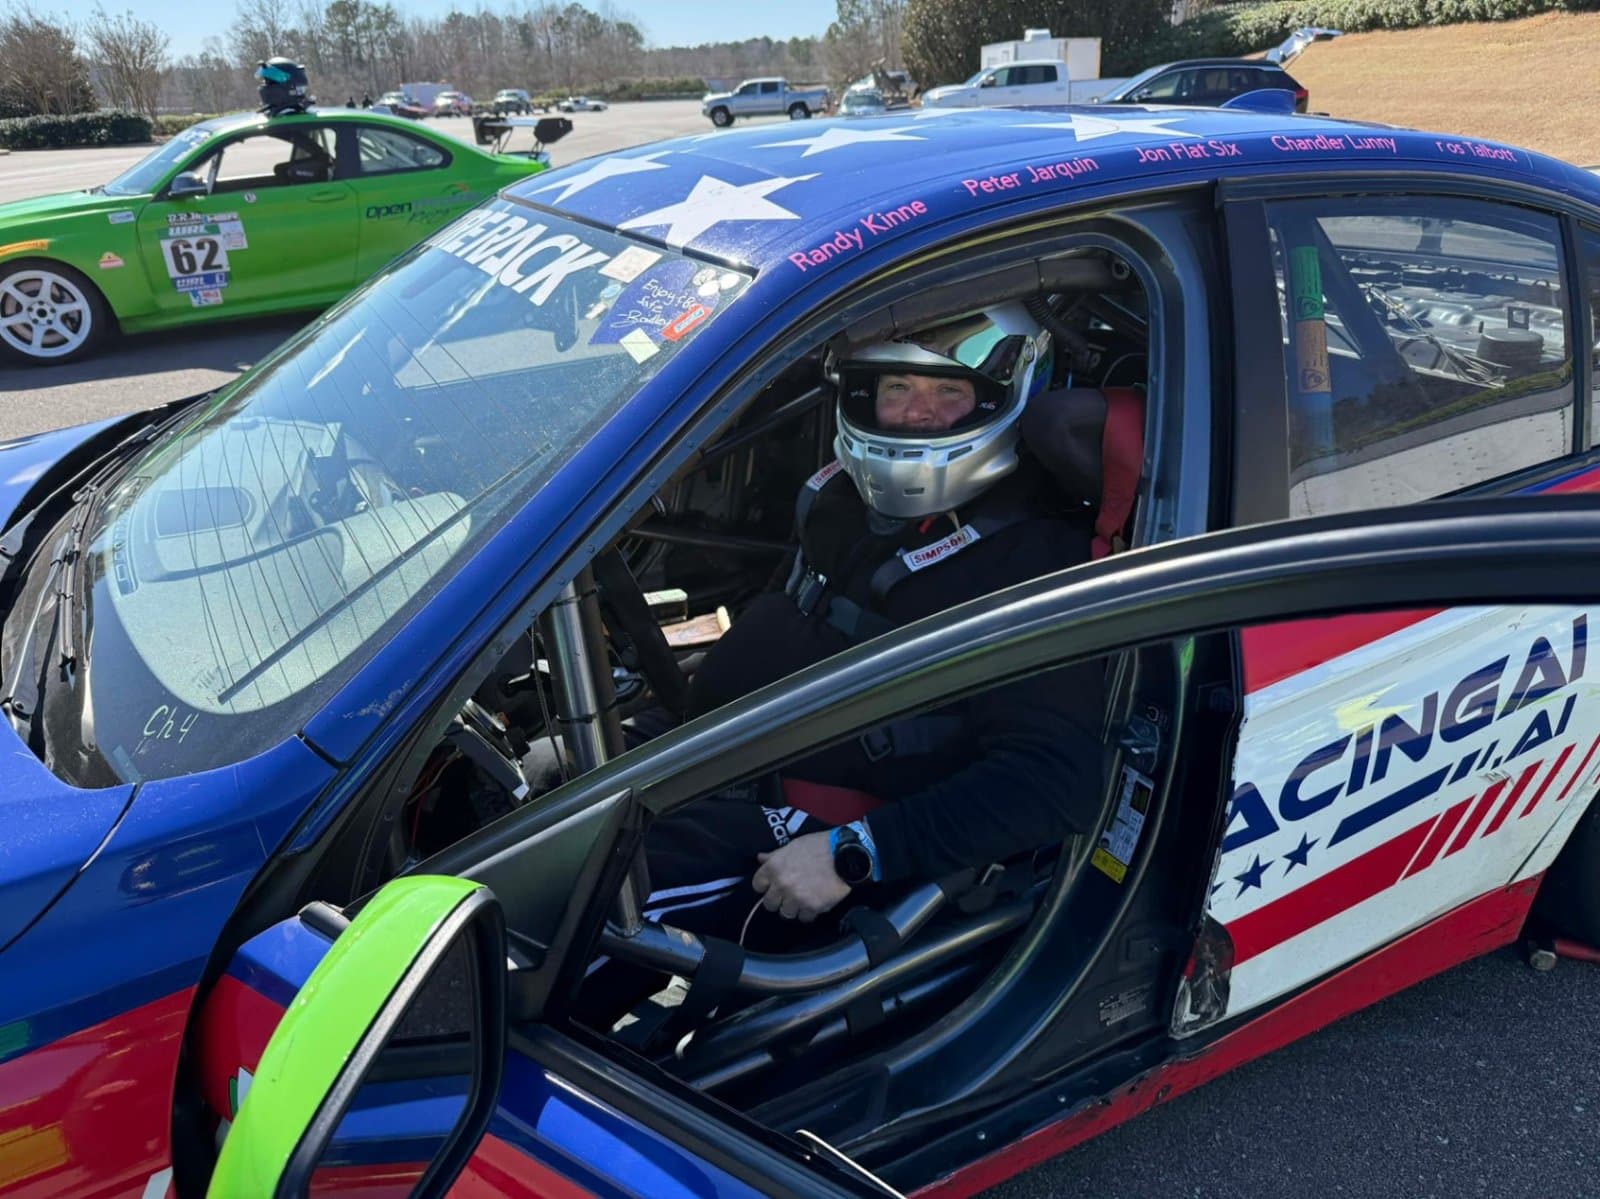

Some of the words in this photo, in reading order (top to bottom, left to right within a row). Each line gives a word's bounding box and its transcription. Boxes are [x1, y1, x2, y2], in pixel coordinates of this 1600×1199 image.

[1135, 146, 1172, 163] Jon
[1168, 142, 1211, 159] Flat
[1207, 139, 1243, 157] Six
[1270, 133, 1347, 151] Chandler
[1344, 133, 1397, 154] Lunny
[1462, 141, 1518, 163] Talbott
[960, 172, 1022, 197] Peter
[1025, 156, 1100, 184] Jarquin
[787, 228, 864, 273] Randy
[860, 199, 928, 236] Kinne
[170, 238, 223, 275] 62
[178, 713, 199, 744] 4
